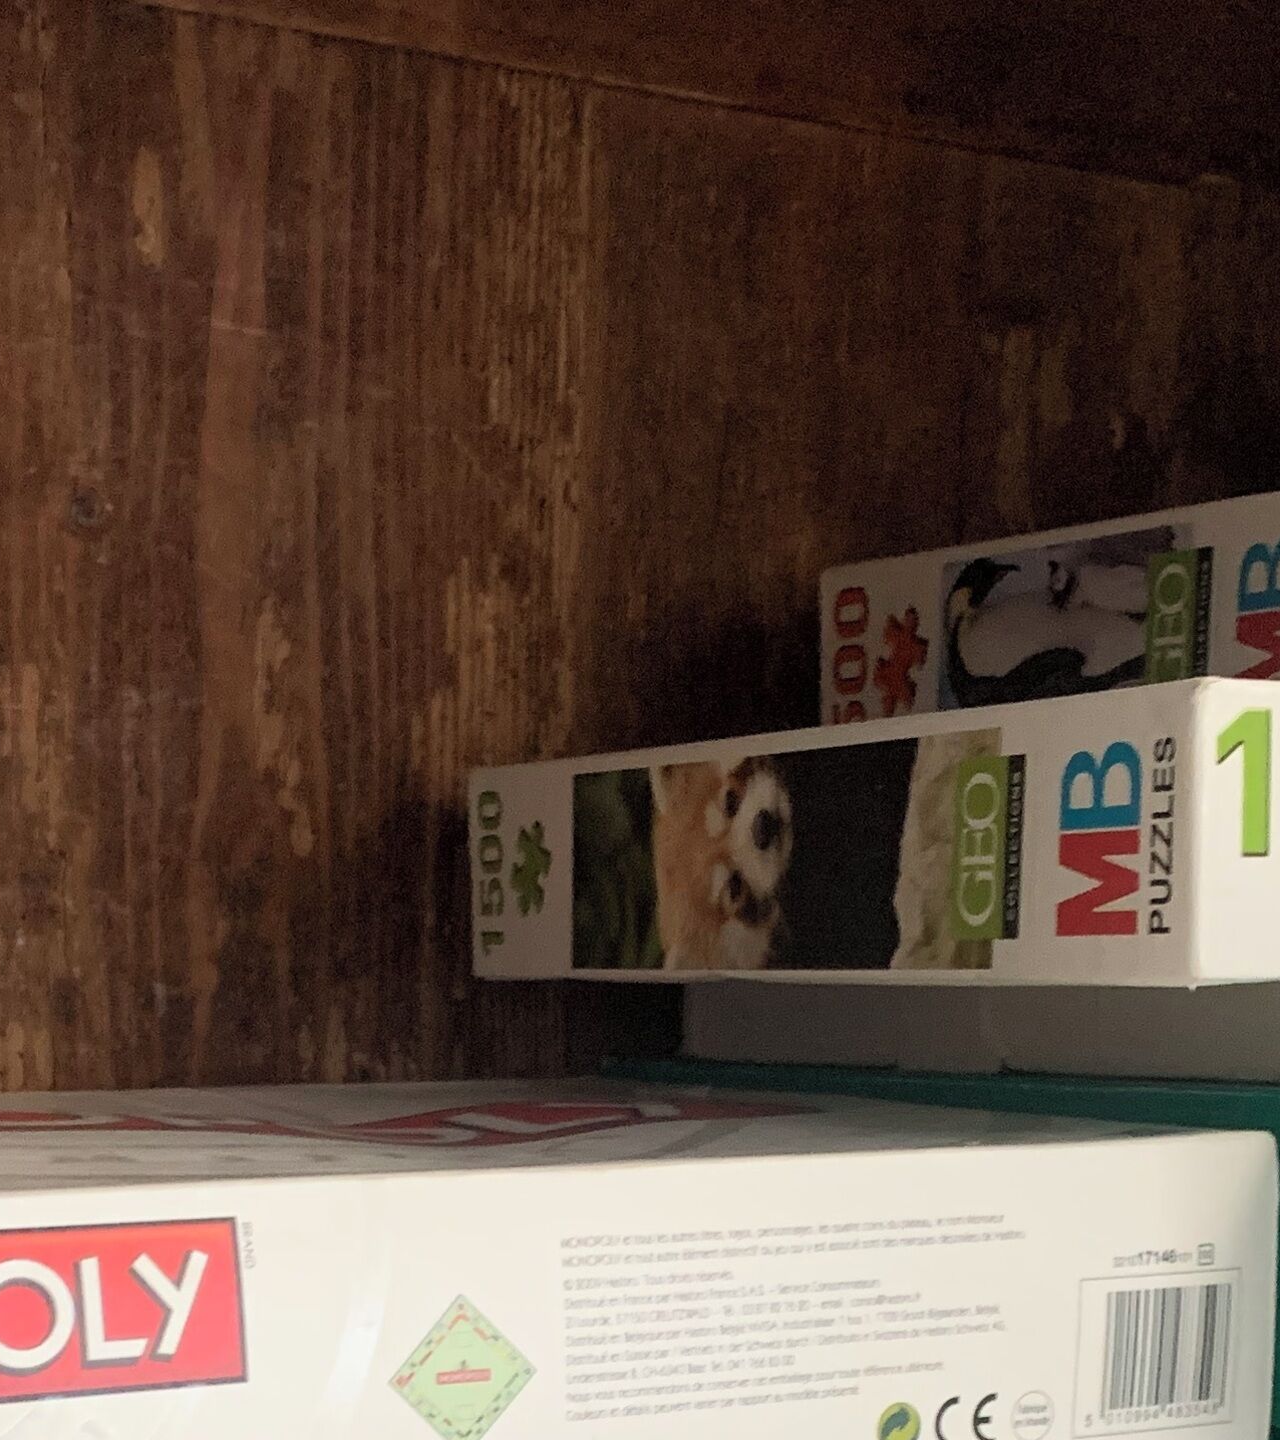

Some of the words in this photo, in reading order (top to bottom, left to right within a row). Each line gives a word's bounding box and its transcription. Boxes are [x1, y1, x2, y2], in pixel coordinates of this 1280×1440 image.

[477, 789, 505, 956] 1500
[957, 771, 1001, 927] GEO
[1056, 740, 1144, 938] MB
[1147, 736, 1177, 936] PUZZLES
